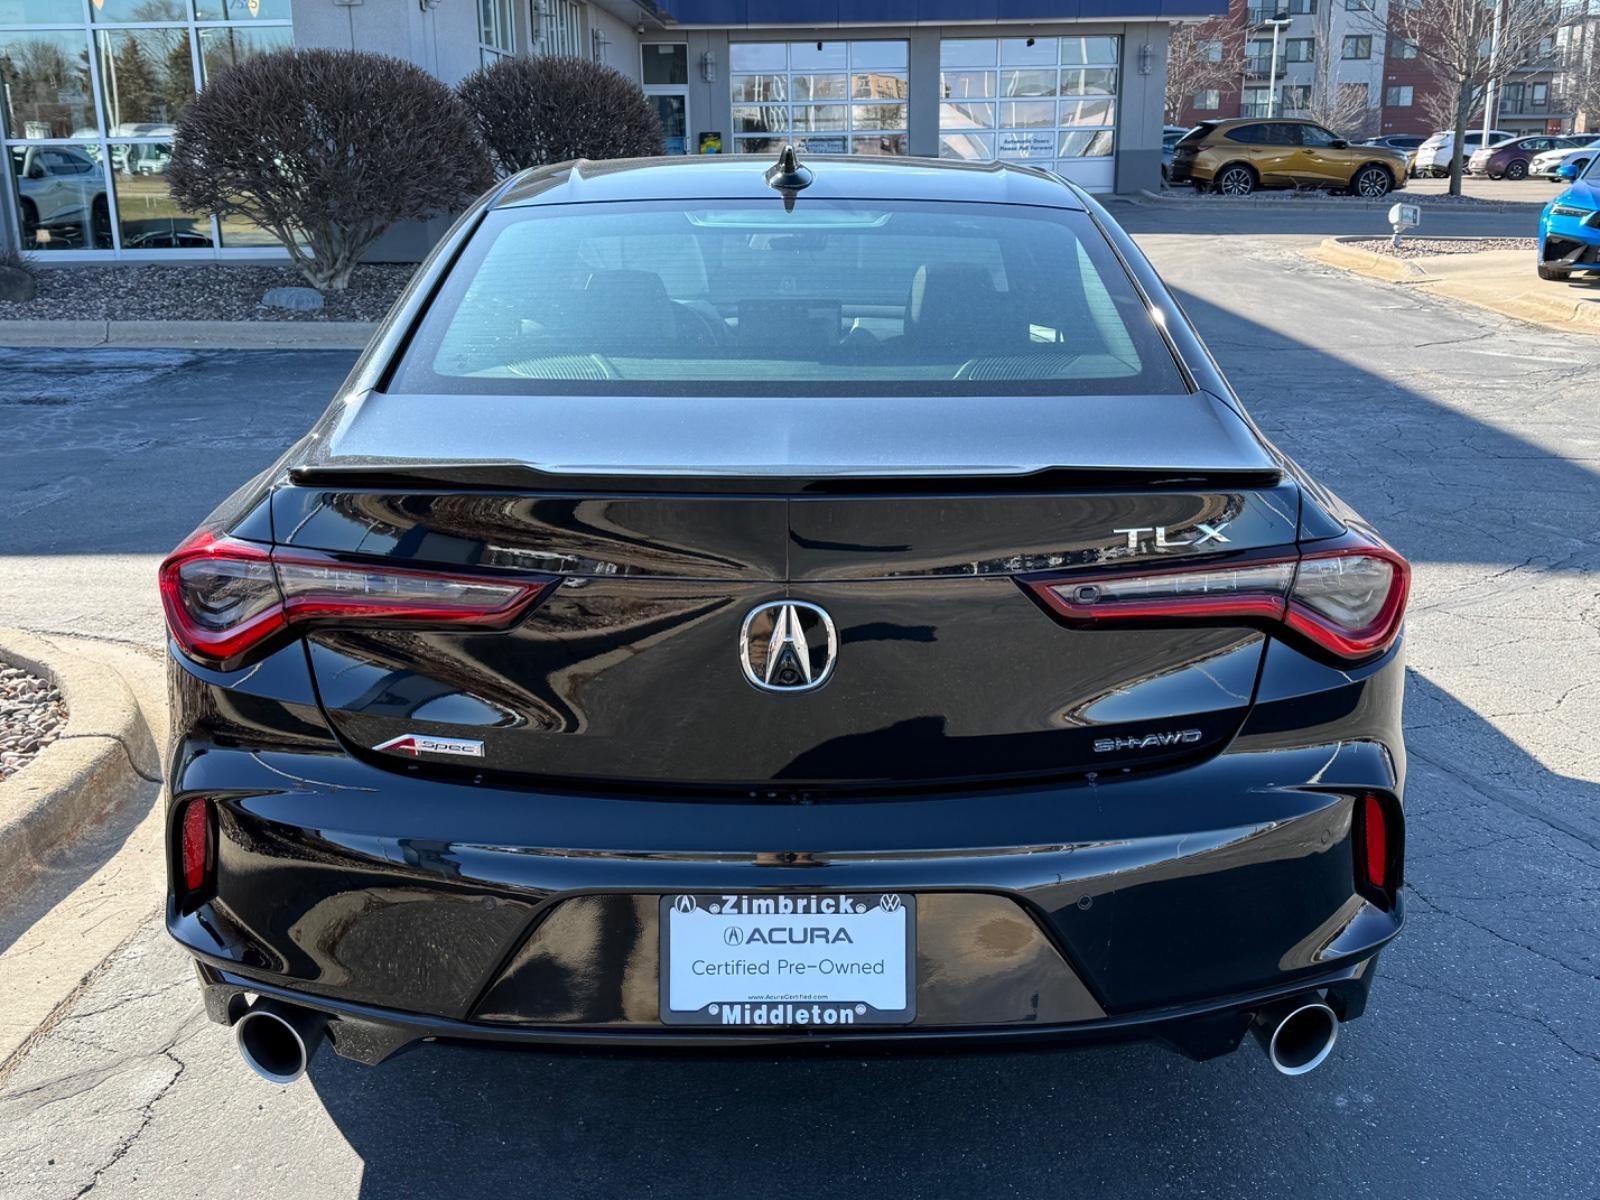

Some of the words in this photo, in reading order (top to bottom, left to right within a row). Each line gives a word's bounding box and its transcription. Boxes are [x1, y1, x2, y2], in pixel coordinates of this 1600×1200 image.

[1113, 522, 1232, 549] TLX
[721, 895, 854, 914] Zimbrick
[745, 927, 854, 944] ACURA
[691, 959, 770, 976] Certified
[777, 958, 885, 975] Pre-Owned
[721, 1004, 855, 1025] Middleton
